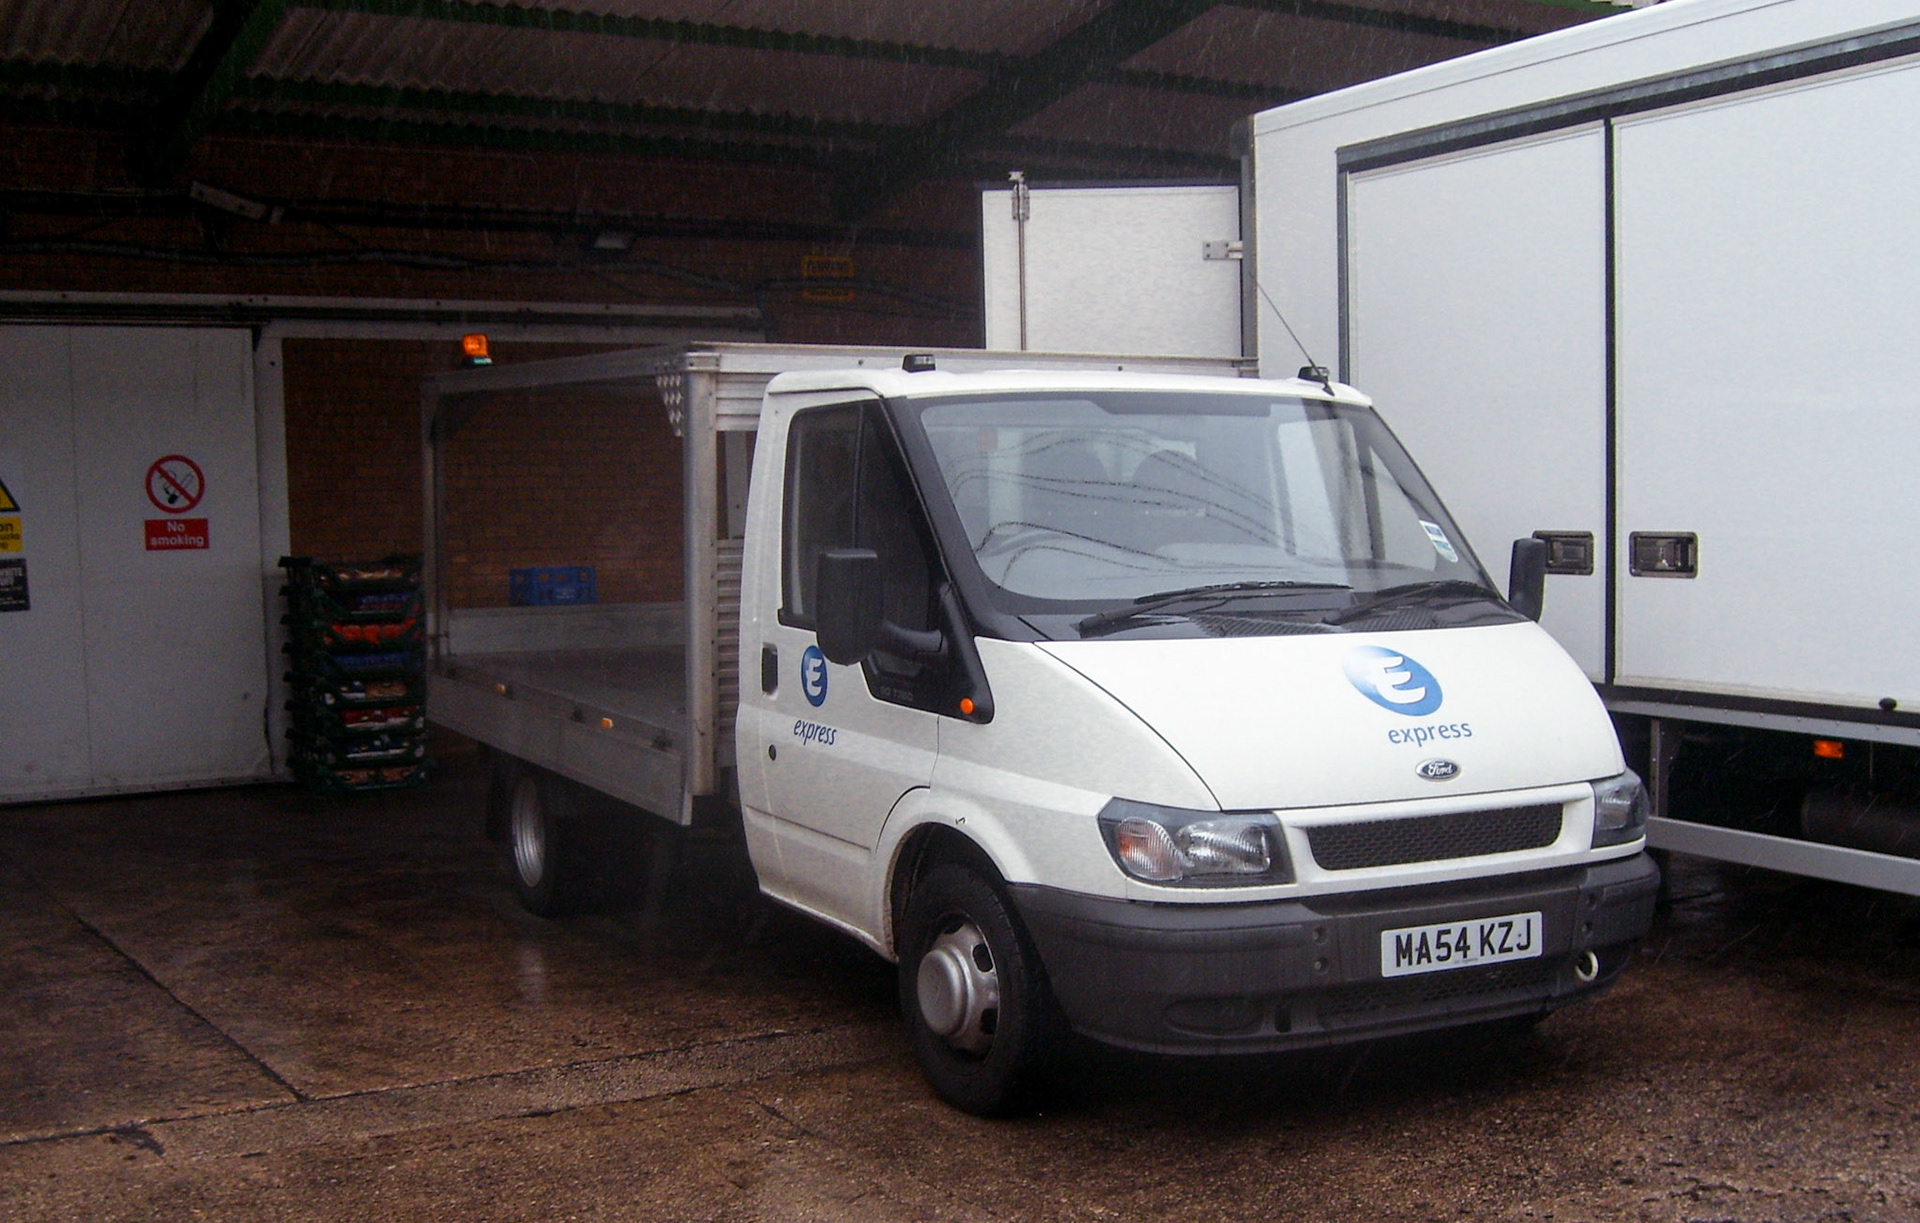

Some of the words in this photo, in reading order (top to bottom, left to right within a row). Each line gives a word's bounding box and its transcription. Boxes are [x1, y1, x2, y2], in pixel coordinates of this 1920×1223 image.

[166, 520, 186, 533] No
[149, 534, 205, 548] smoking
[793, 719, 838, 746] express
[1388, 722, 1473, 748] express
[1395, 926, 1471, 968] MA54
[1479, 918, 1532, 958] KZJ
